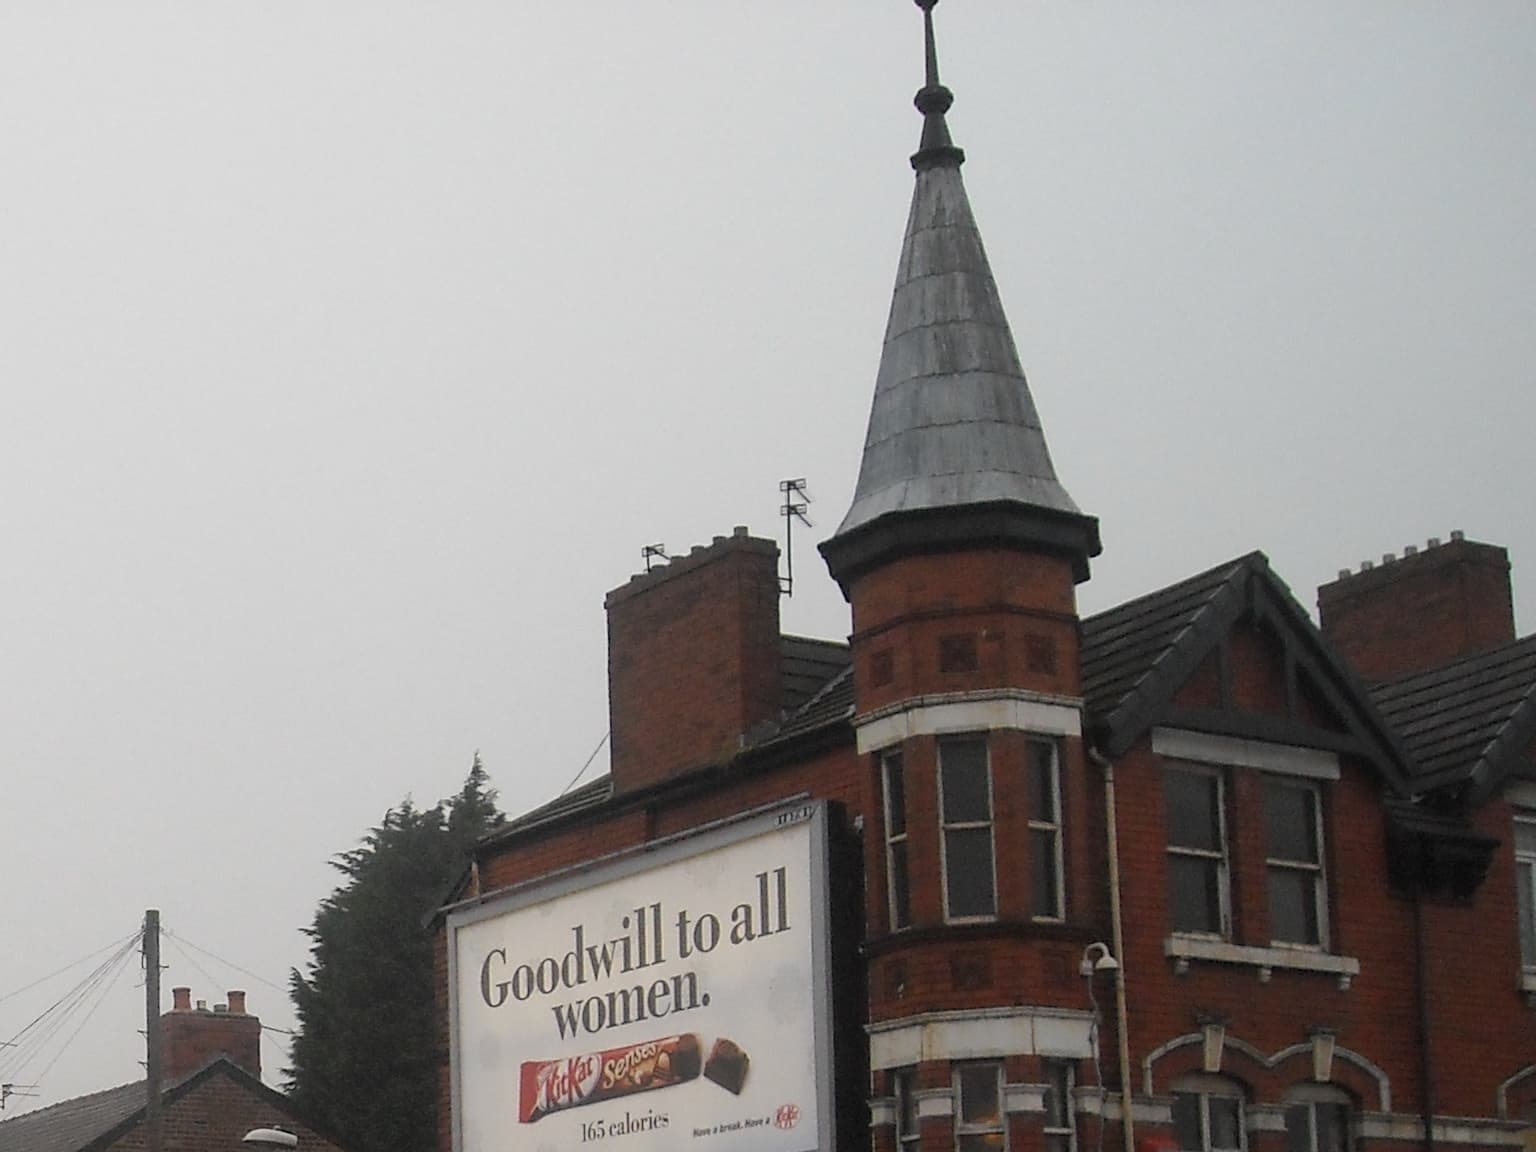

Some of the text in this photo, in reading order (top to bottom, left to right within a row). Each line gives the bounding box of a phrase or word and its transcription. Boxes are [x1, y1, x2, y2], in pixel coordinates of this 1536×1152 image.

[480, 866, 792, 1008] Goodwill to all
[552, 971, 711, 1041] women.
[537, 1043, 660, 1111] KitKat Senses
[581, 1109, 670, 1143] 165 calories
[692, 1128, 711, 1137] Have
[744, 1118, 764, 1128] Have
